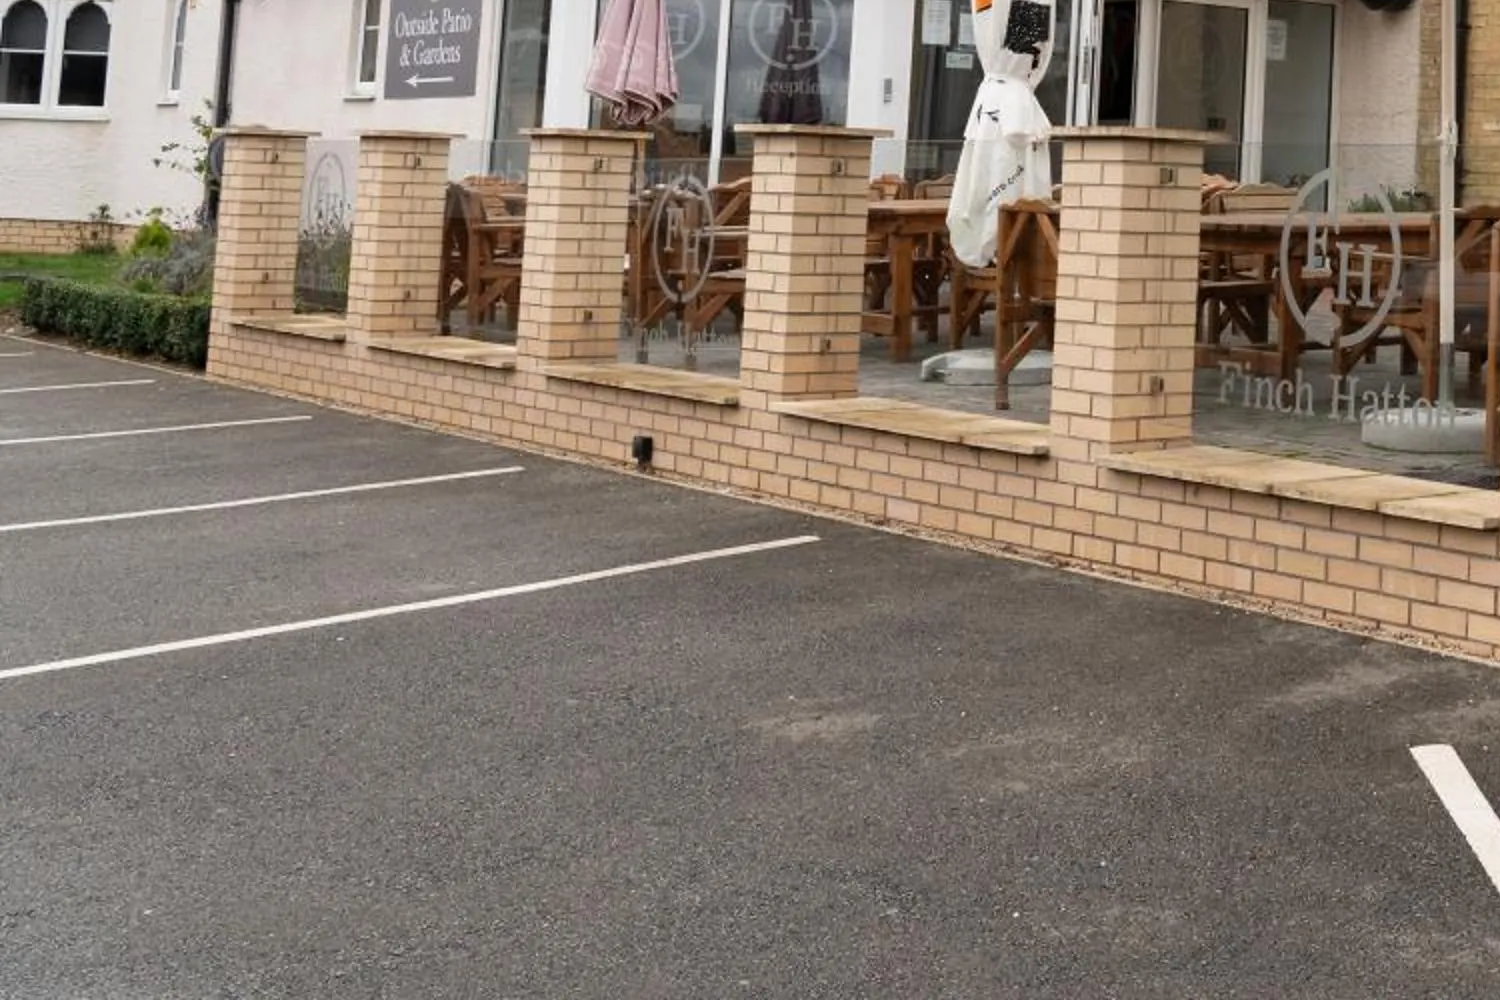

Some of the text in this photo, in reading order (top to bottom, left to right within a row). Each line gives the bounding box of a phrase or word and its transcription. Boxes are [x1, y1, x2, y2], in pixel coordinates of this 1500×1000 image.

[395, 7, 472, 38] Outside Patio
[399, 39, 462, 68] & Gardens
[1216, 360, 1456, 428] Finch Hatton
